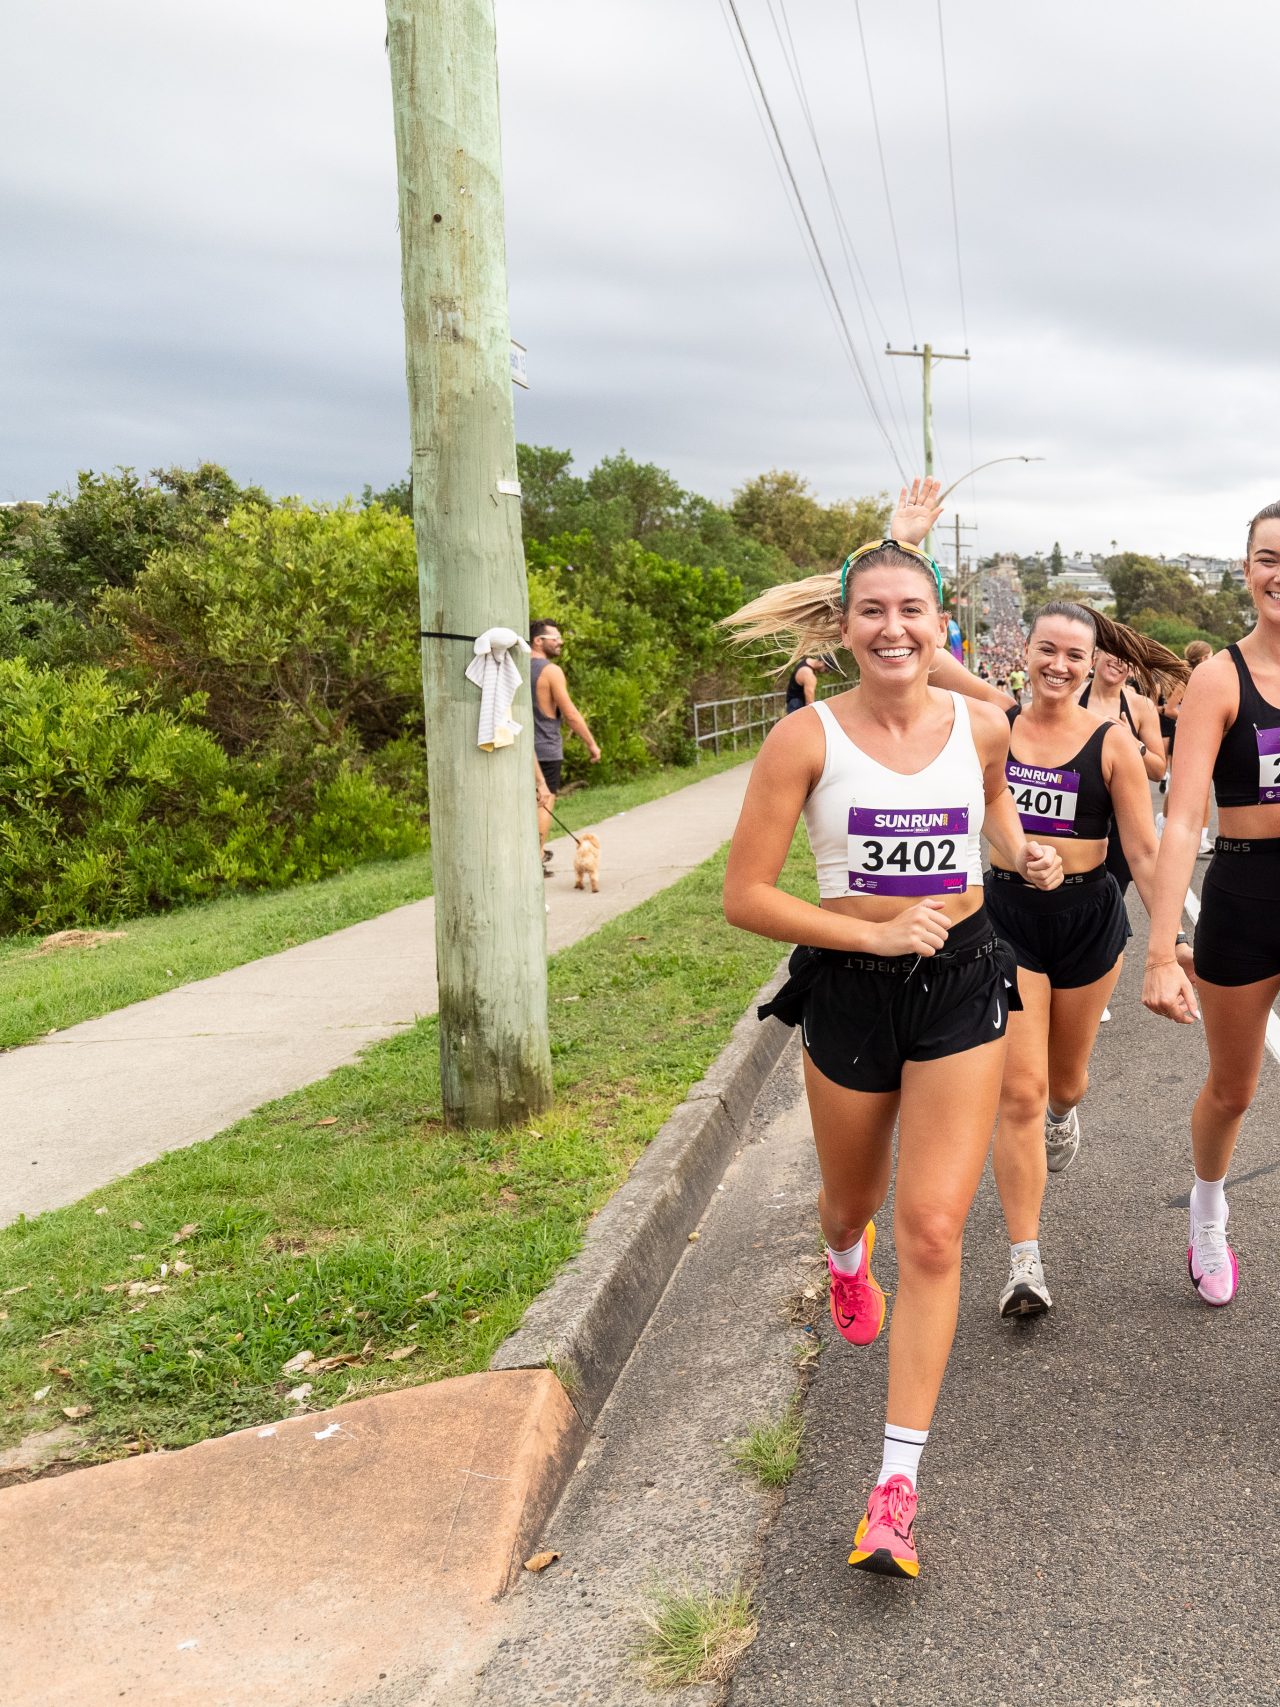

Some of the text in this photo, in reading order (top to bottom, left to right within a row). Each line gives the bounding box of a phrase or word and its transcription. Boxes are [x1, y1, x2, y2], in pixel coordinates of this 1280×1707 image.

[1009, 766, 1033, 779] SUN
[1033, 769, 1058, 784] RUN
[1008, 785, 1063, 817] 401
[874, 814, 910, 828] SUN
[910, 813, 944, 828] RUN
[861, 839, 957, 873] 3402
